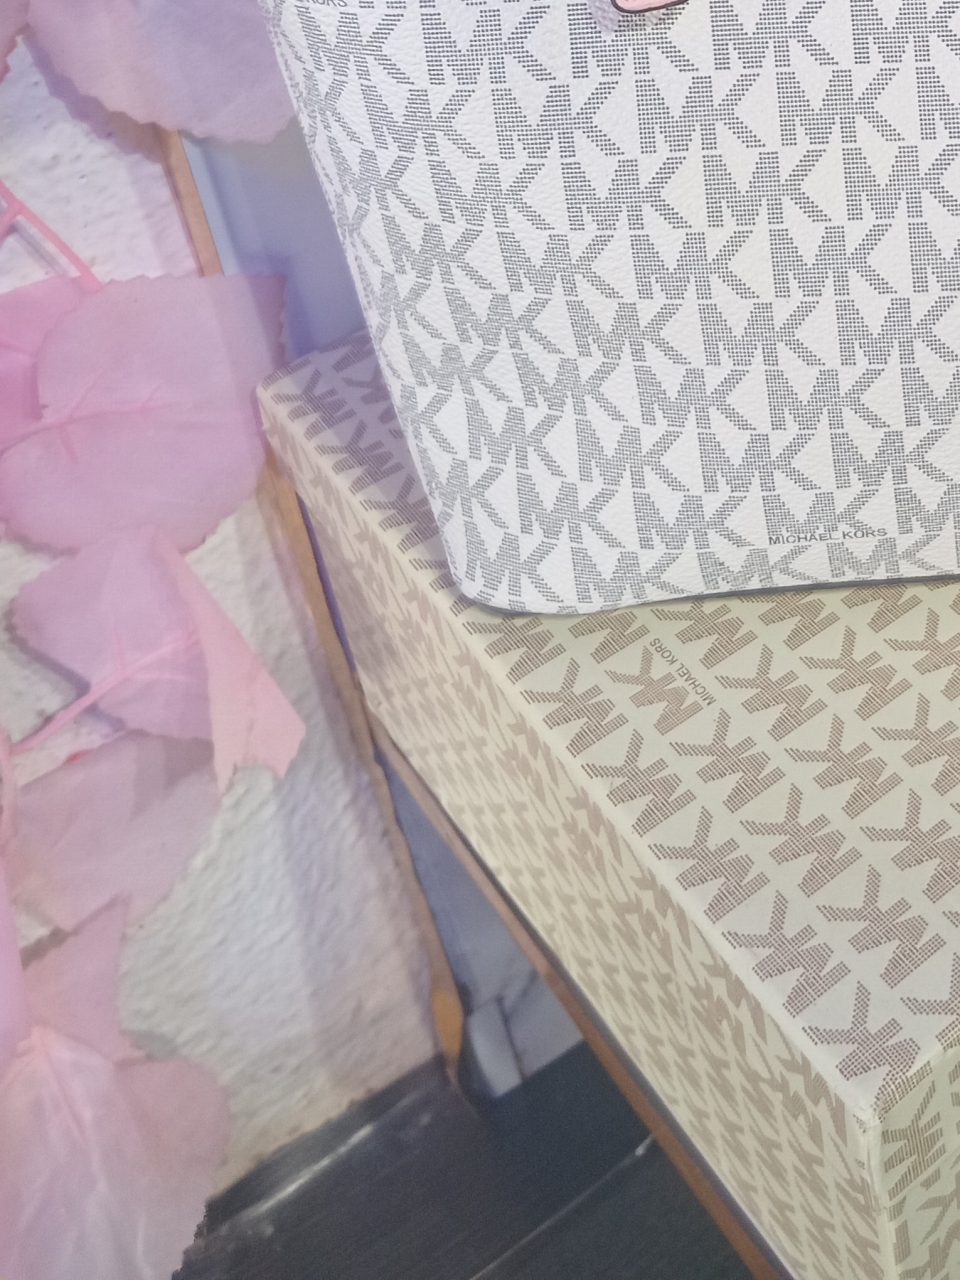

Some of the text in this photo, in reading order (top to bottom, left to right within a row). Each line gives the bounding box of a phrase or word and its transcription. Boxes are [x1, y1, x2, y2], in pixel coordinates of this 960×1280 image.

[768, 527, 888, 546] MICHAEL KORS
[649, 637, 717, 707] MICHAEL KORS
